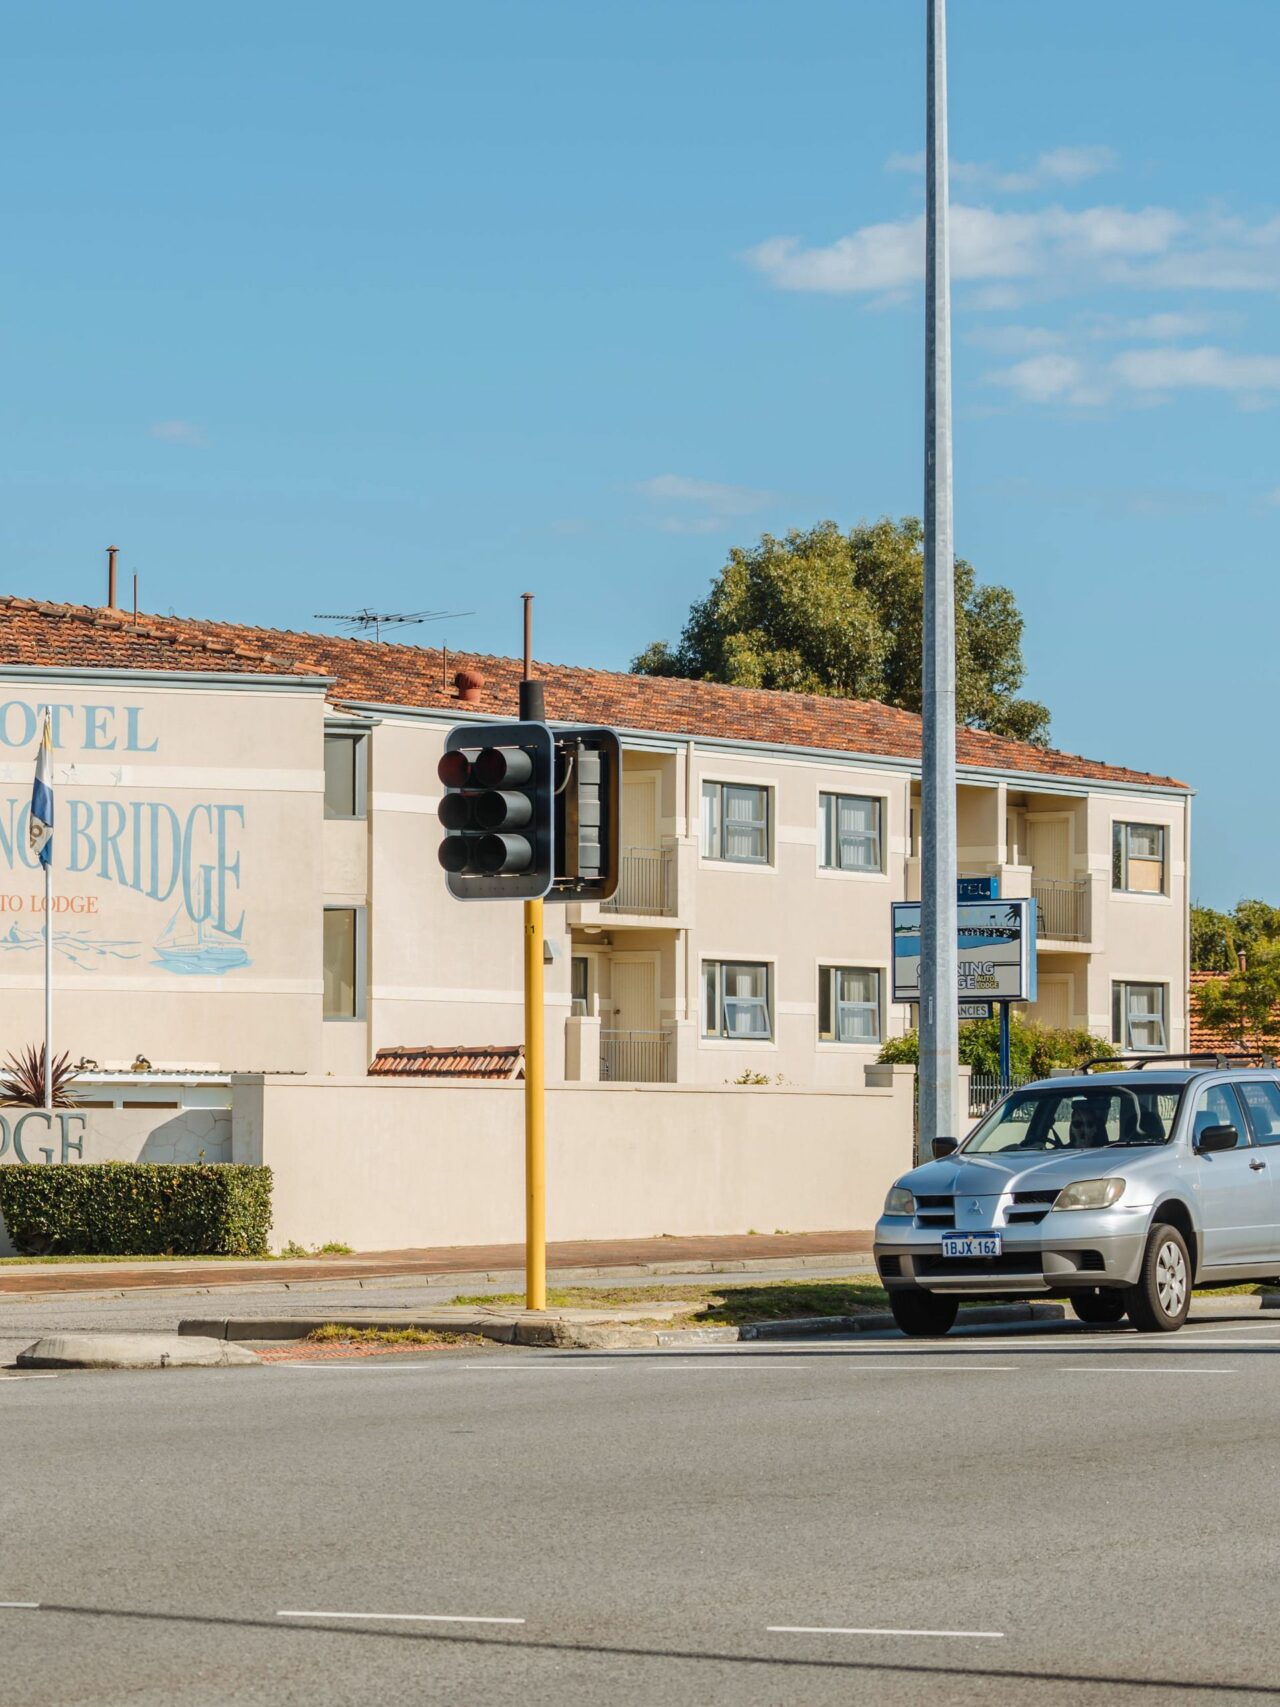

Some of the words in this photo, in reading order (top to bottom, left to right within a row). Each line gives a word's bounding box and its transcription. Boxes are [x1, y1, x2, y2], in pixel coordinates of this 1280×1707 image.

[66, 799, 246, 940] BRIDGE
[30, 895, 99, 914] LODGE
[958, 1005, 987, 1016] NCIES
